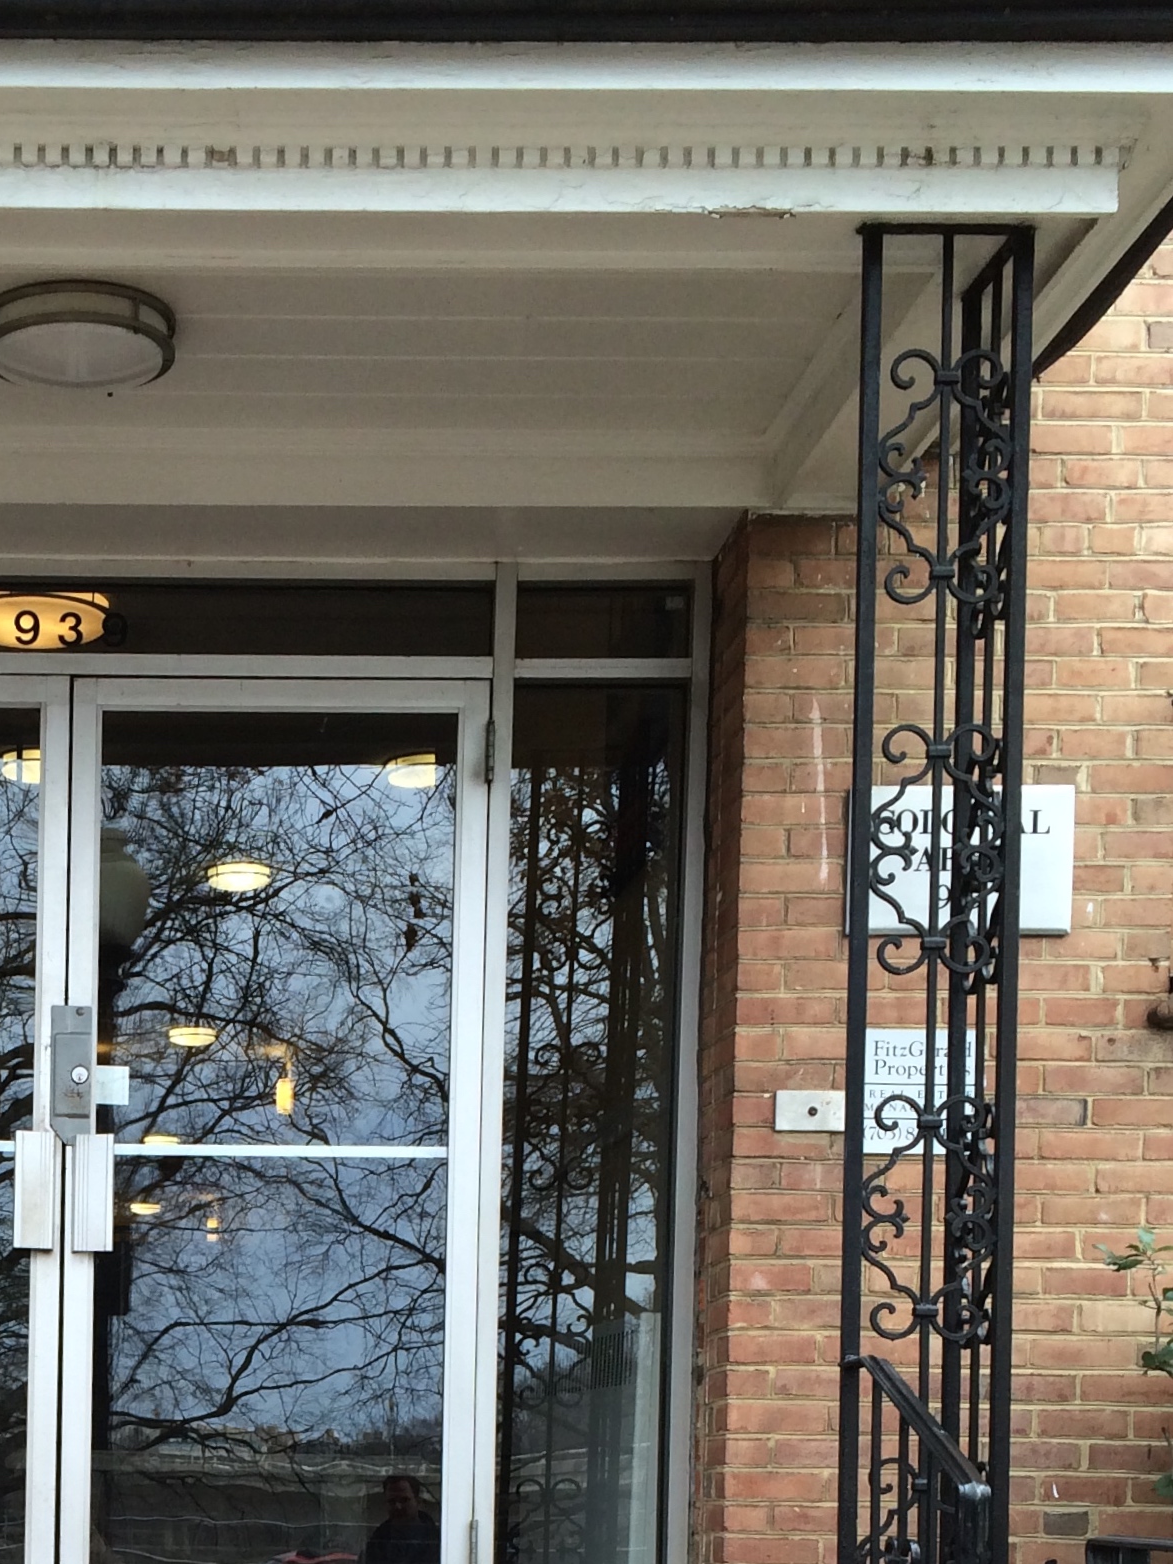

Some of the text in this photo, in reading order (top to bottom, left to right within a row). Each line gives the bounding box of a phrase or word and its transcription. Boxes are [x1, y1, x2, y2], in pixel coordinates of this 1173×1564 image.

[878, 809, 1051, 835] COLOL
[873, 1040, 972, 1058] FitzGrad
[874, 1059, 971, 1079] Propets
[917, 1090, 973, 1100] ETE
